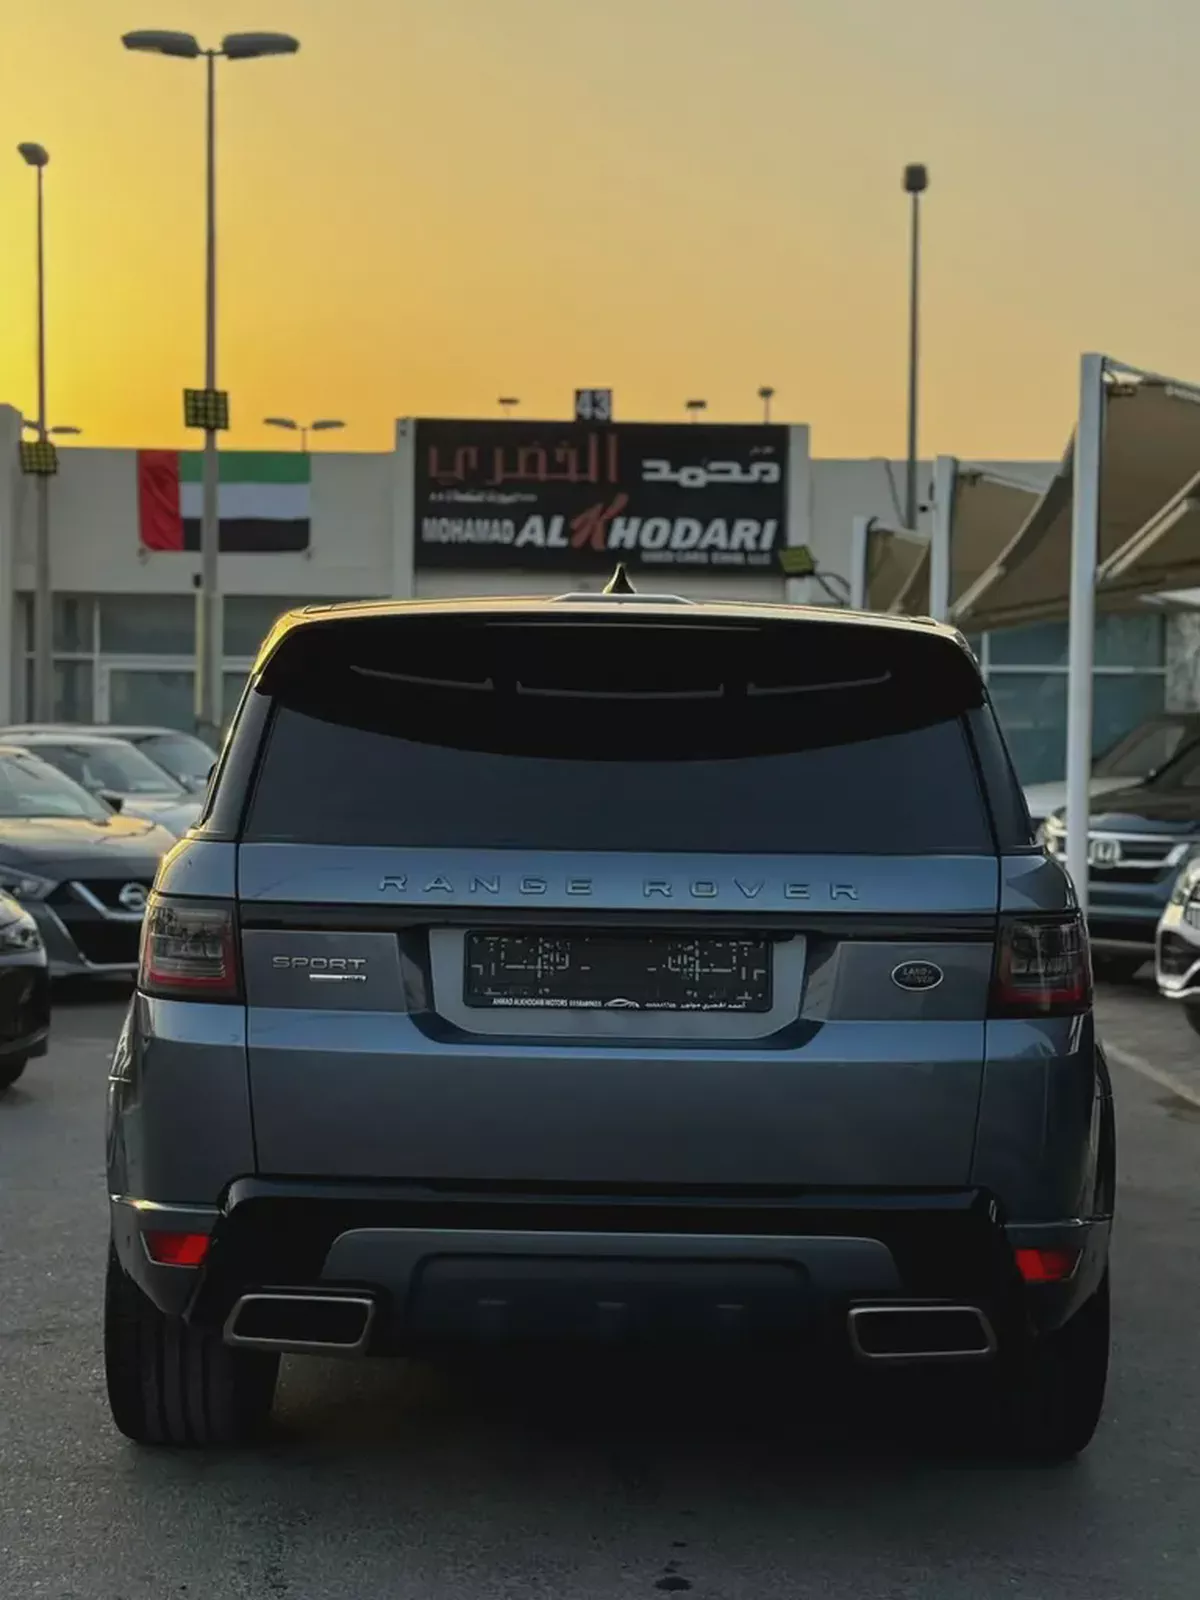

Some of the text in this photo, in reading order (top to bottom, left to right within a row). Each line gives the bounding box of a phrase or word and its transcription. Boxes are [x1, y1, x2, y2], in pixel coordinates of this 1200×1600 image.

[576, 390, 610, 420] 43
[641, 457, 780, 488] محمد
[422, 517, 514, 545] MOHAMAD
[379, 875, 859, 900] RANGE ROVER
[272, 956, 366, 969] SPORT
